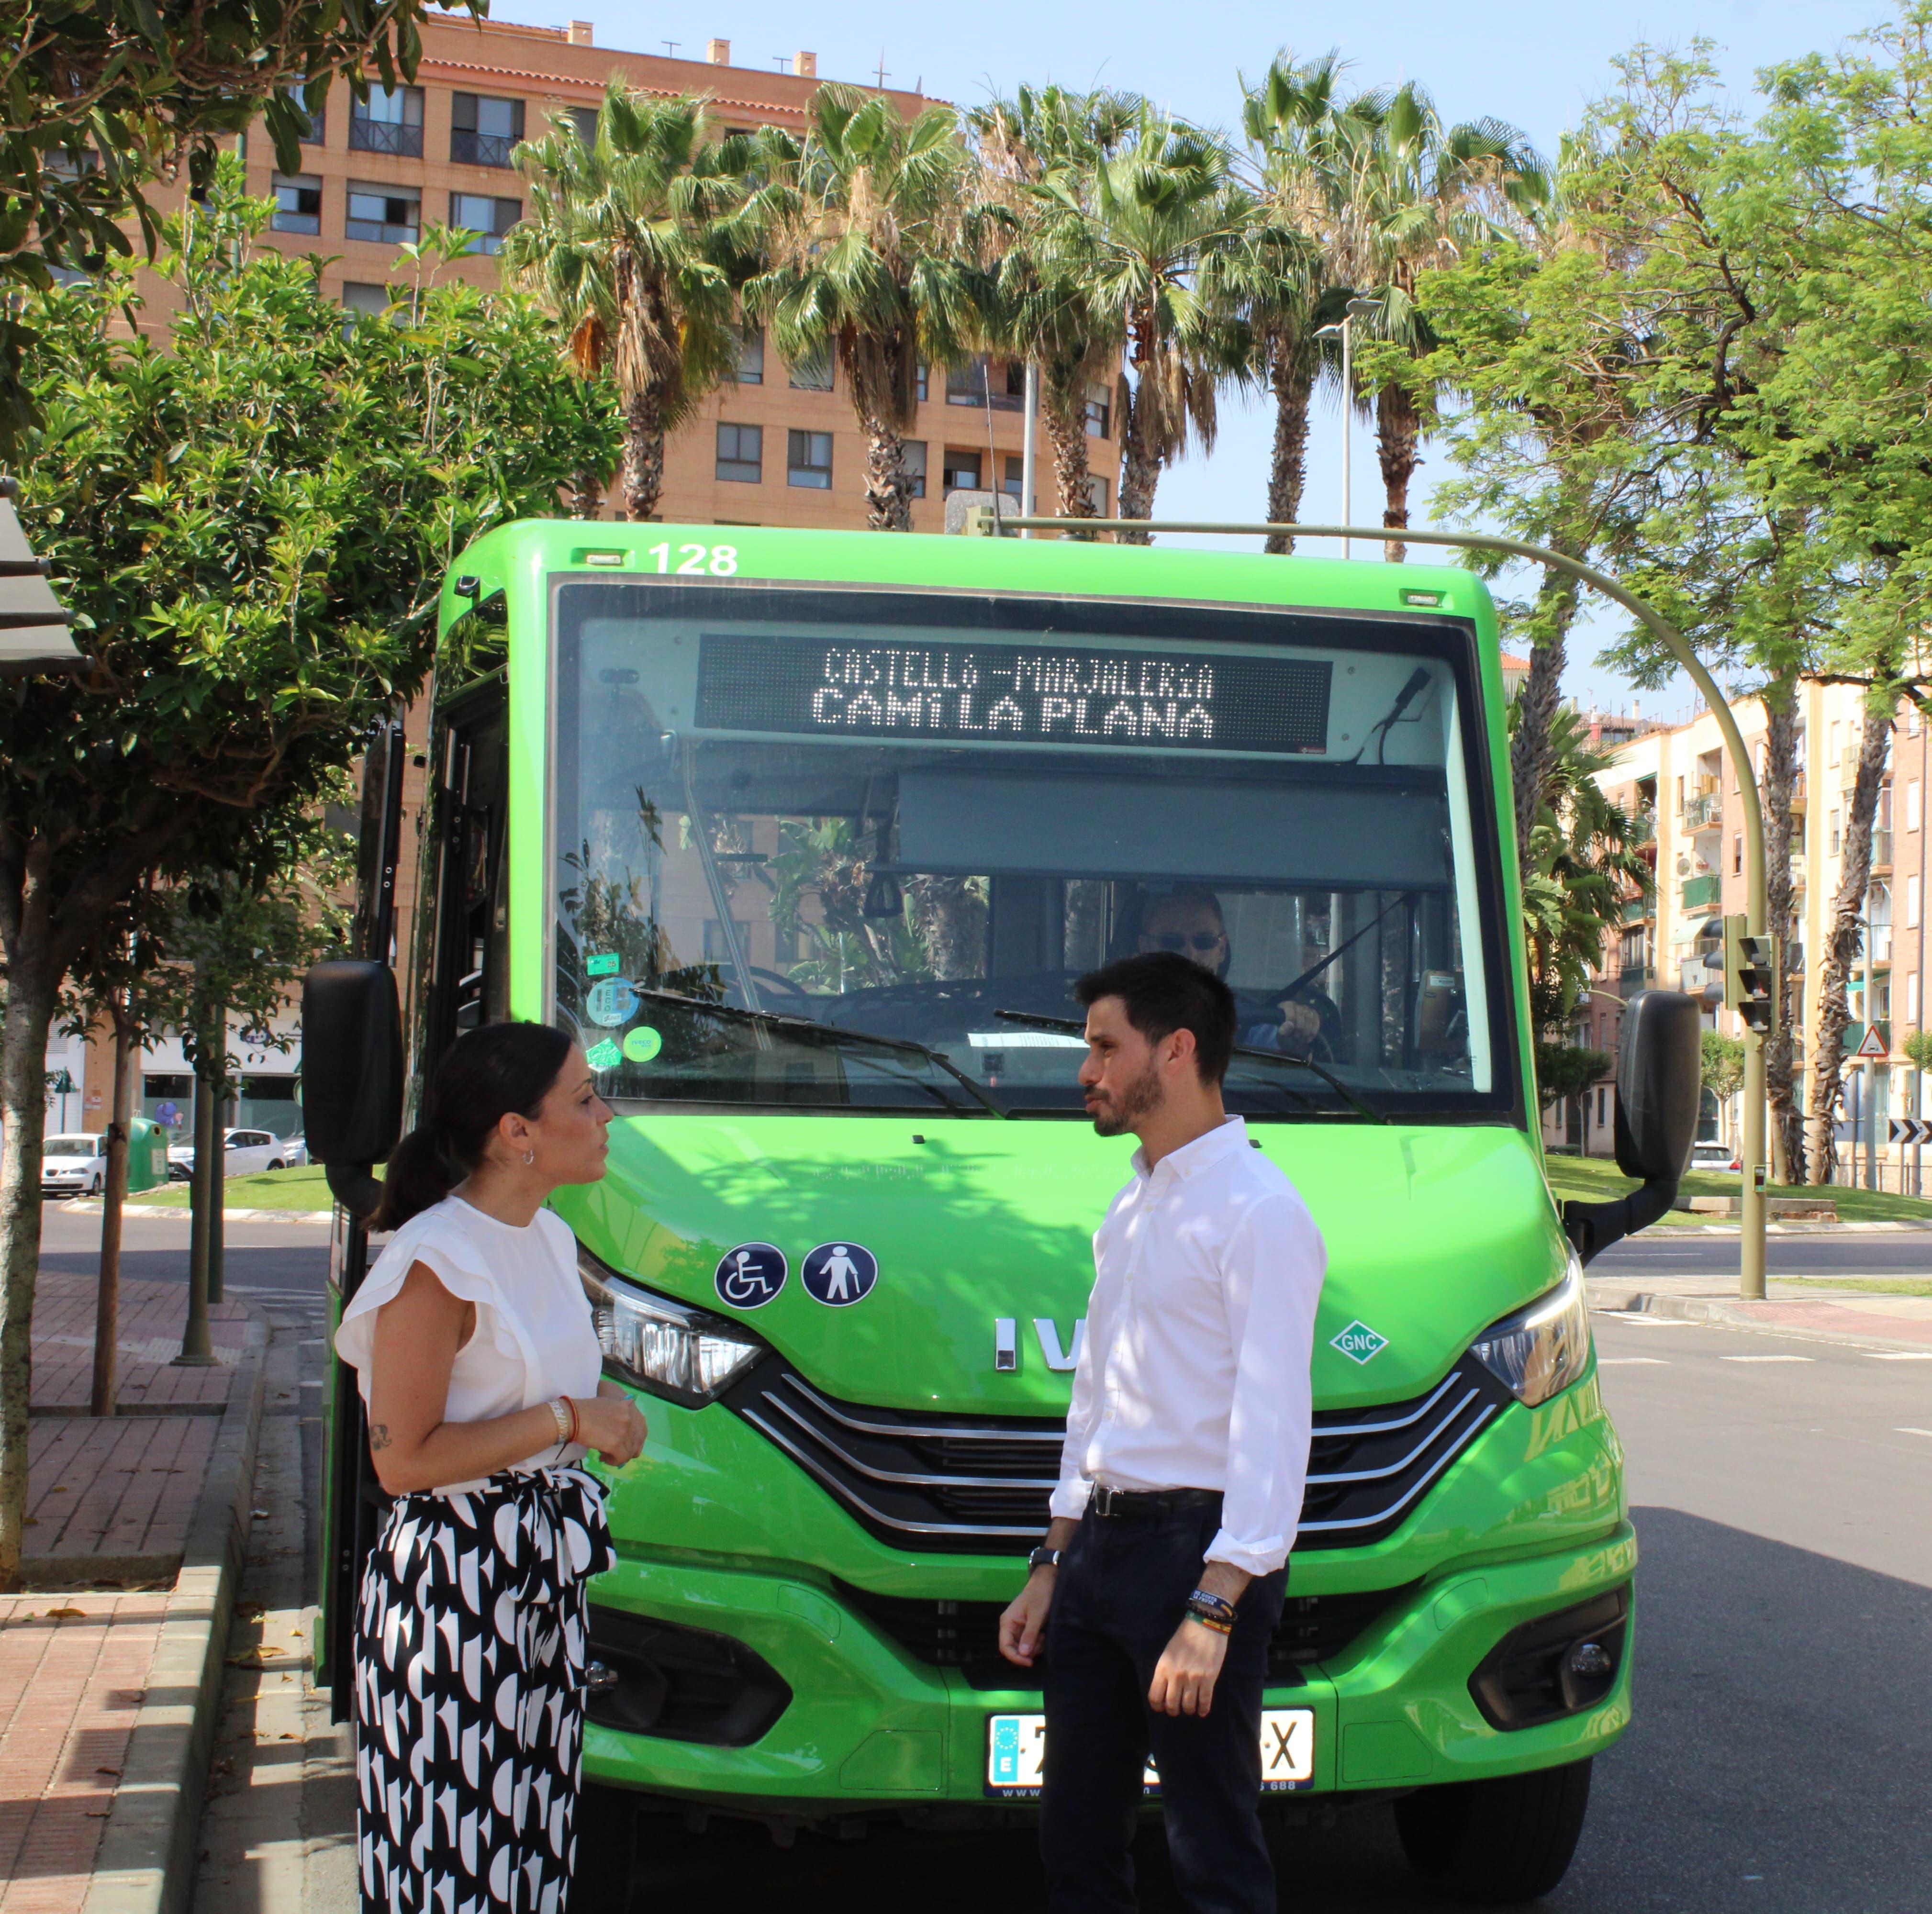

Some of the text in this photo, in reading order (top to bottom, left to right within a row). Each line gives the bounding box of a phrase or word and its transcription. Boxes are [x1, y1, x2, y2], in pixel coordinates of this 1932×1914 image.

[648, 542, 737, 576] 128
[960, 694, 1023, 730] LA
[1041, 698, 1213, 738] PLANA
[995, 1318, 1086, 1371] IV
[1341, 1335, 1377, 1350] GNC
[1000, 1757, 1011, 1772] E
[1270, 1781, 1295, 1791] 688
